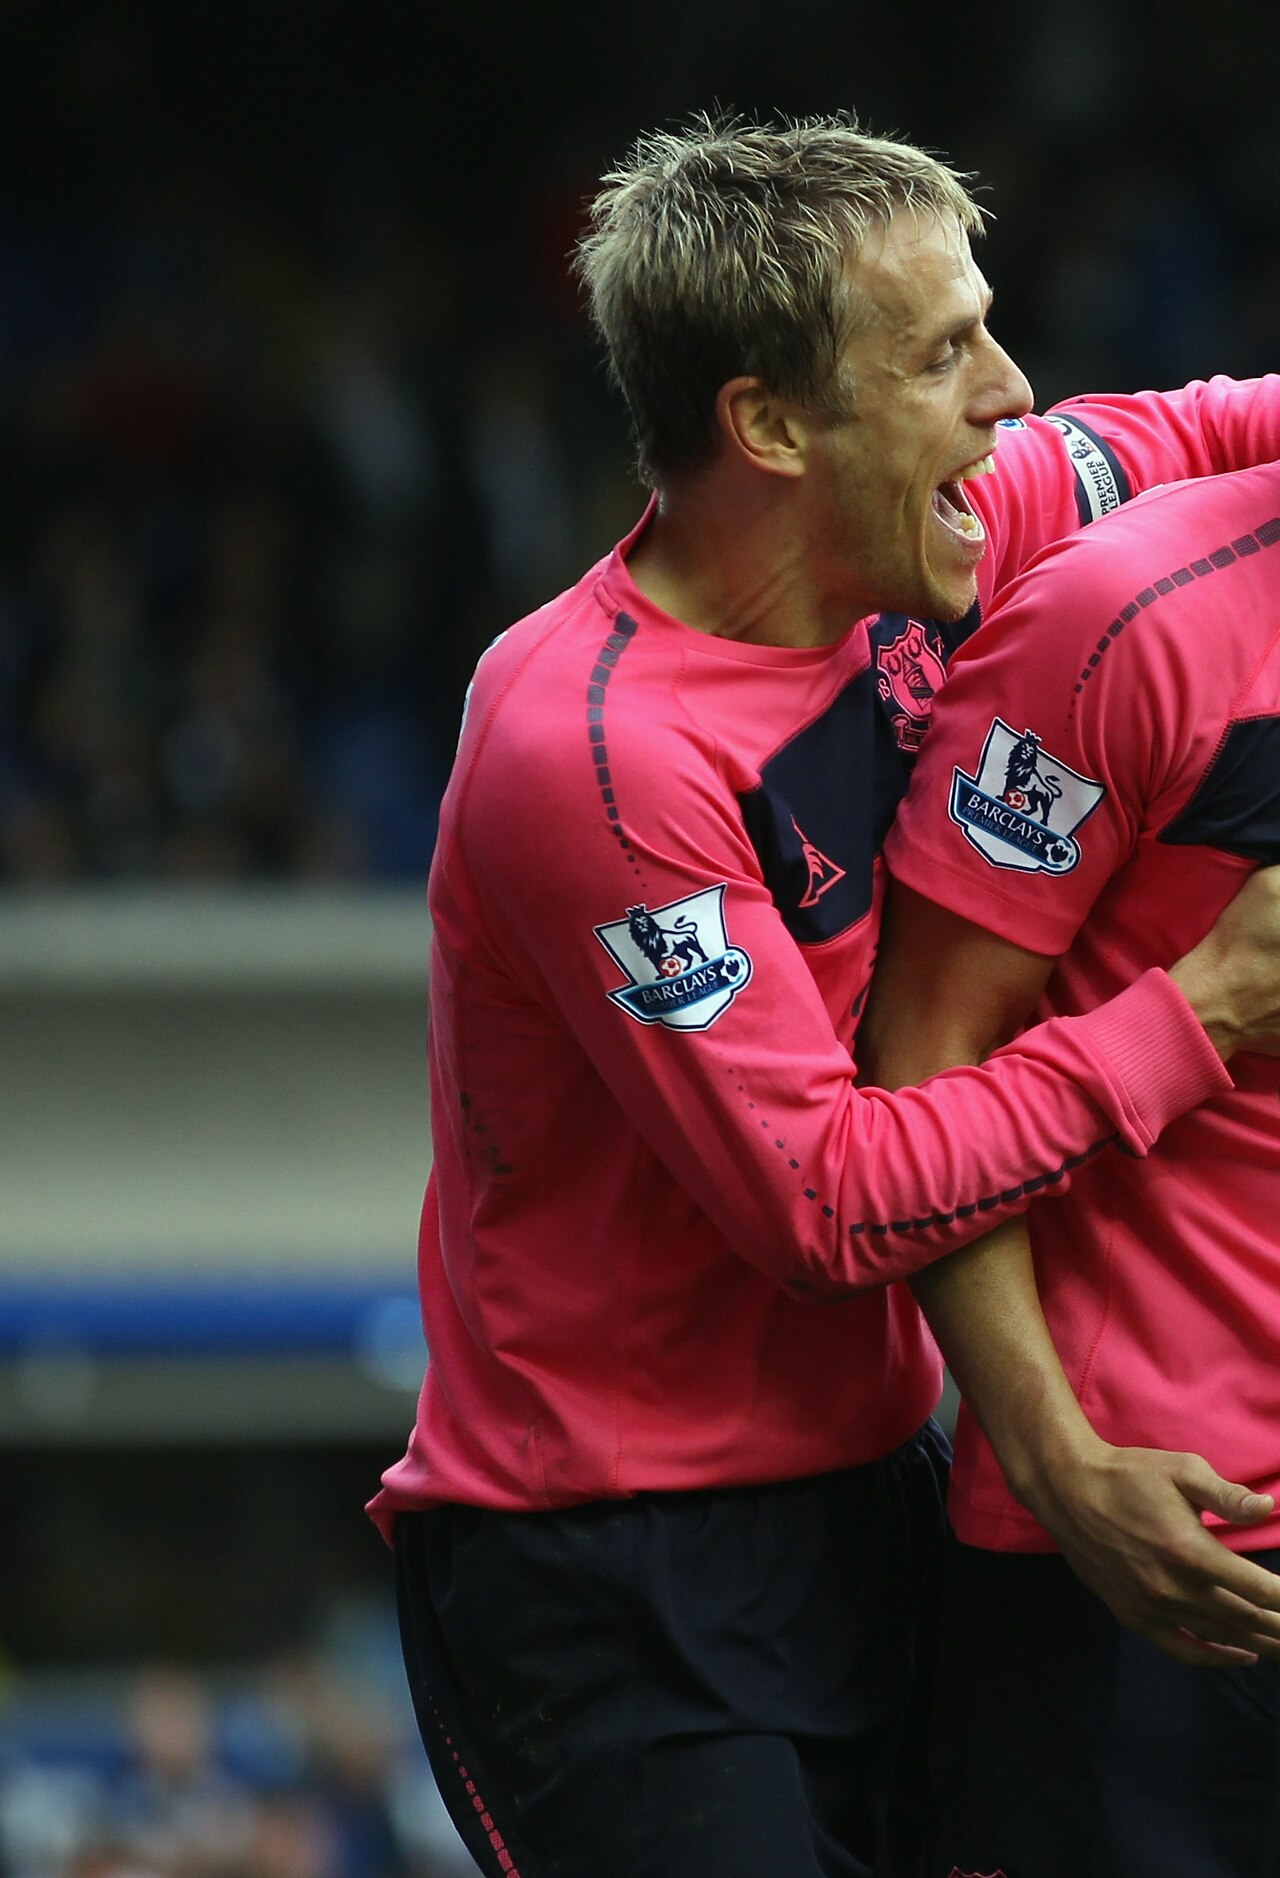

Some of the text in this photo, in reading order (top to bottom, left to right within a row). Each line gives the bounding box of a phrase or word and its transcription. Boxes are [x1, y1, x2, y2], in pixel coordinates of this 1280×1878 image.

[1086, 460, 1110, 515] PREMIER
[1097, 459, 1118, 510] LEAGUE
[962, 806, 1001, 833] PREMIER
[967, 794, 1046, 844] BARCLAYS
[641, 966, 717, 1005] BARCLAYS
[646, 996, 687, 1012] MIER
